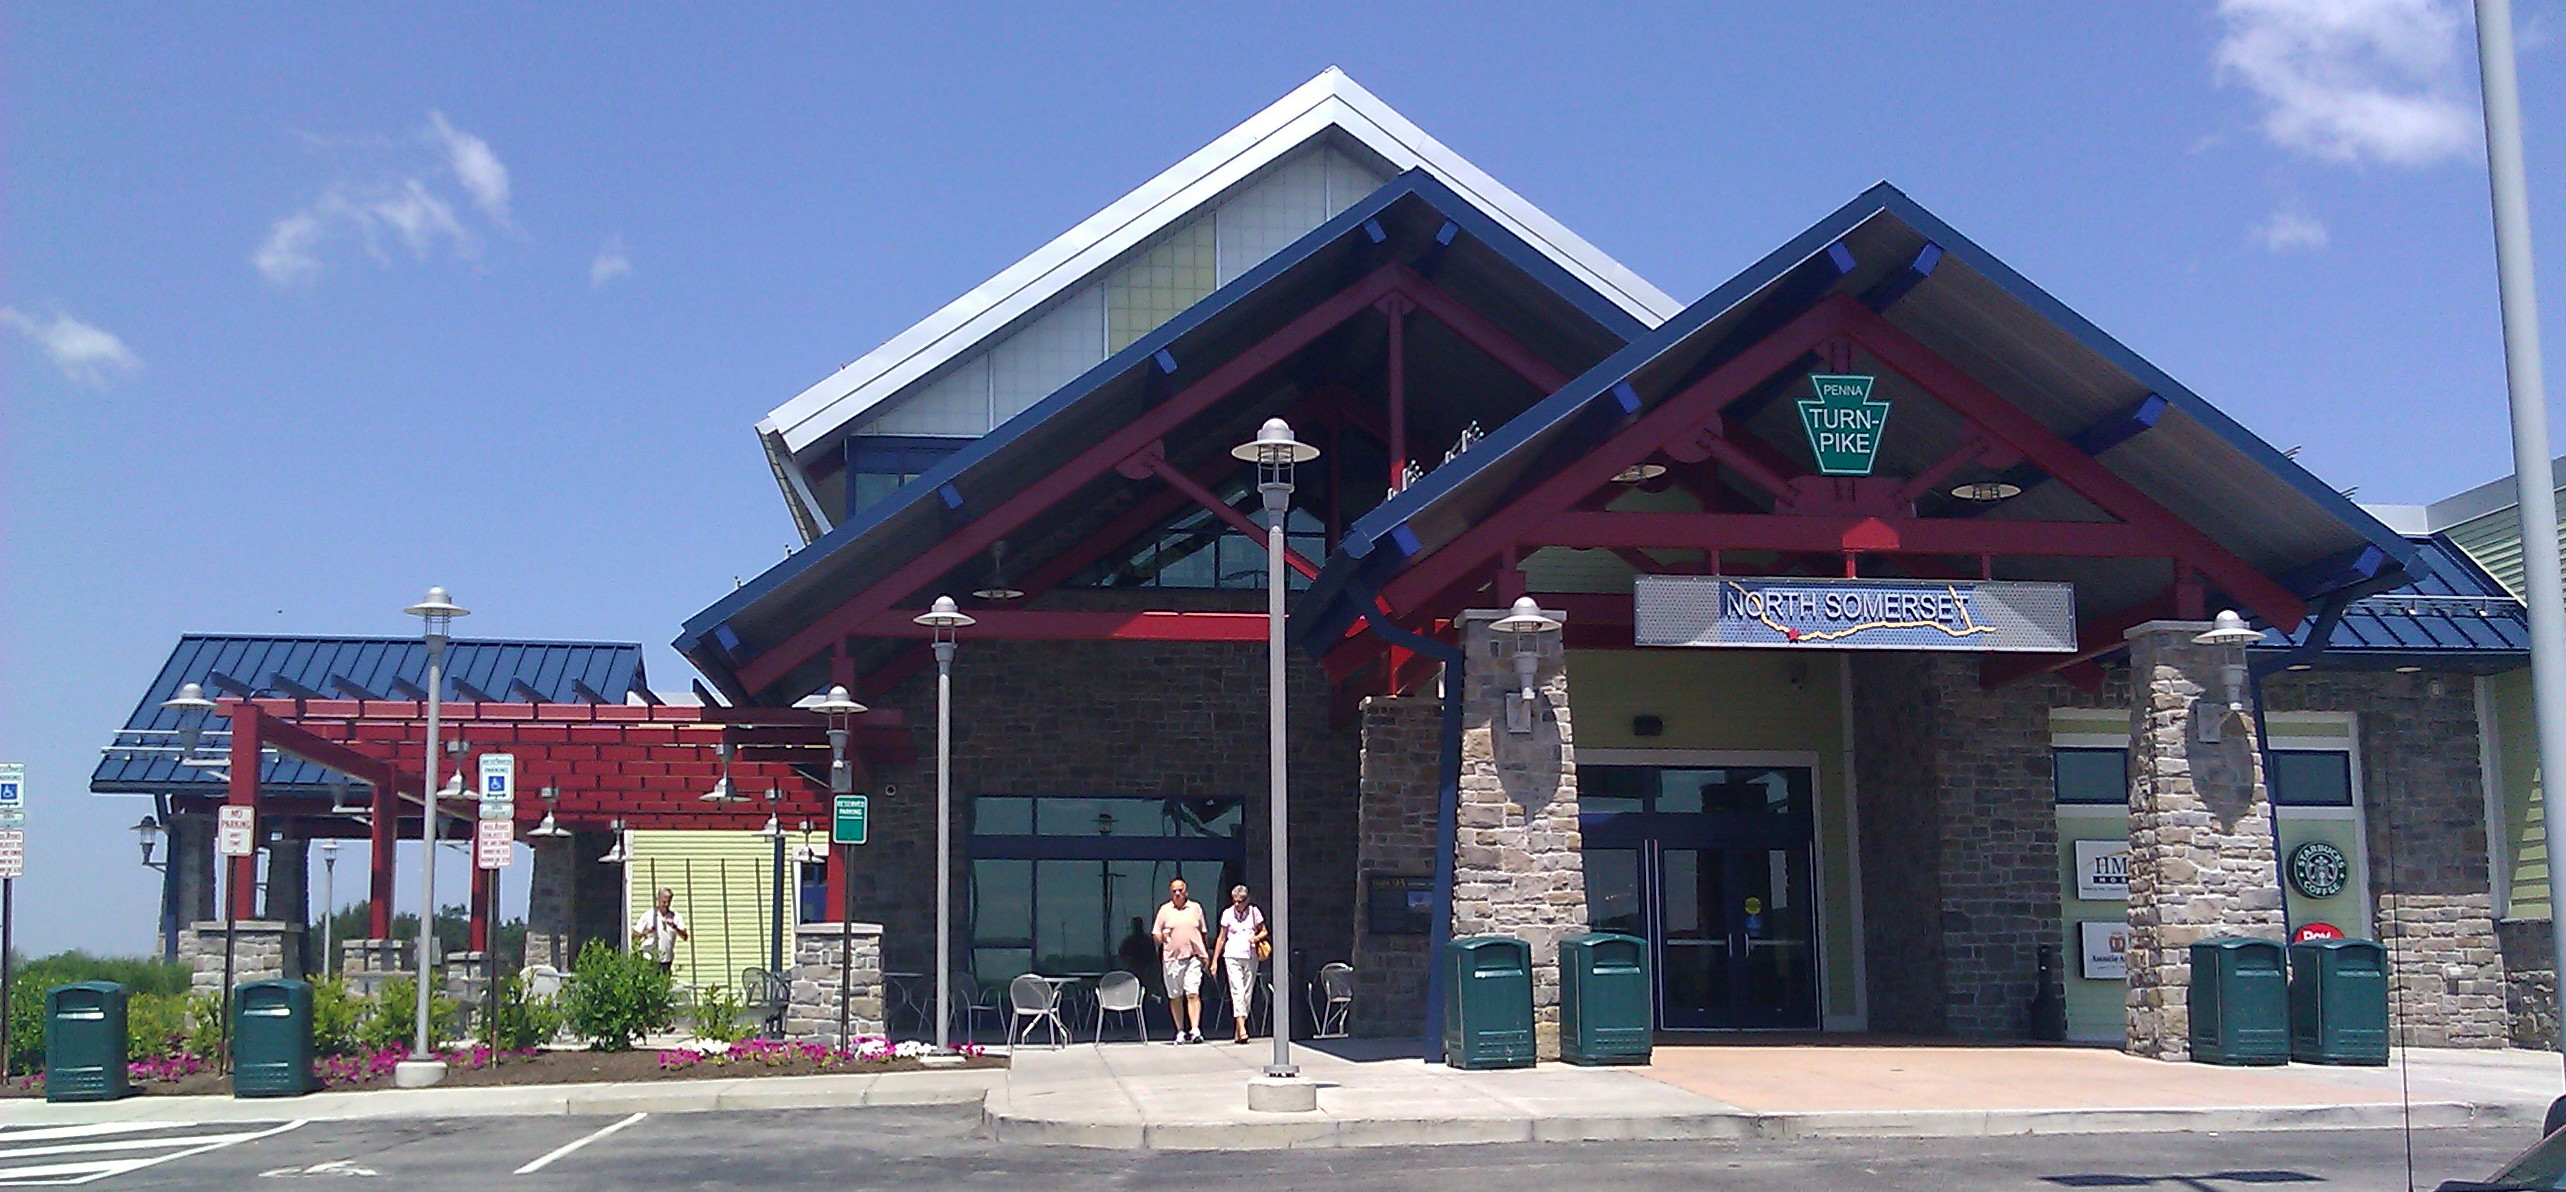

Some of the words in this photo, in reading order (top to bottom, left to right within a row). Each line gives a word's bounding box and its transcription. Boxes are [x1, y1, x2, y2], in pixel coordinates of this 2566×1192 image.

[1823, 384, 1863, 396] PENNA
[1809, 408, 1880, 429] TURN-
[1820, 432, 1871, 454] PIKE
[1726, 590, 1817, 618] NORTH
[1824, 591, 1970, 620] SOMERSET
[231, 810, 243, 818] NO
[221, 820, 252, 829] PARKING
[2095, 856, 2128, 874] HM
[2298, 844, 2345, 868] STARBUCKS
[2303, 881, 2341, 896] COFFEE
